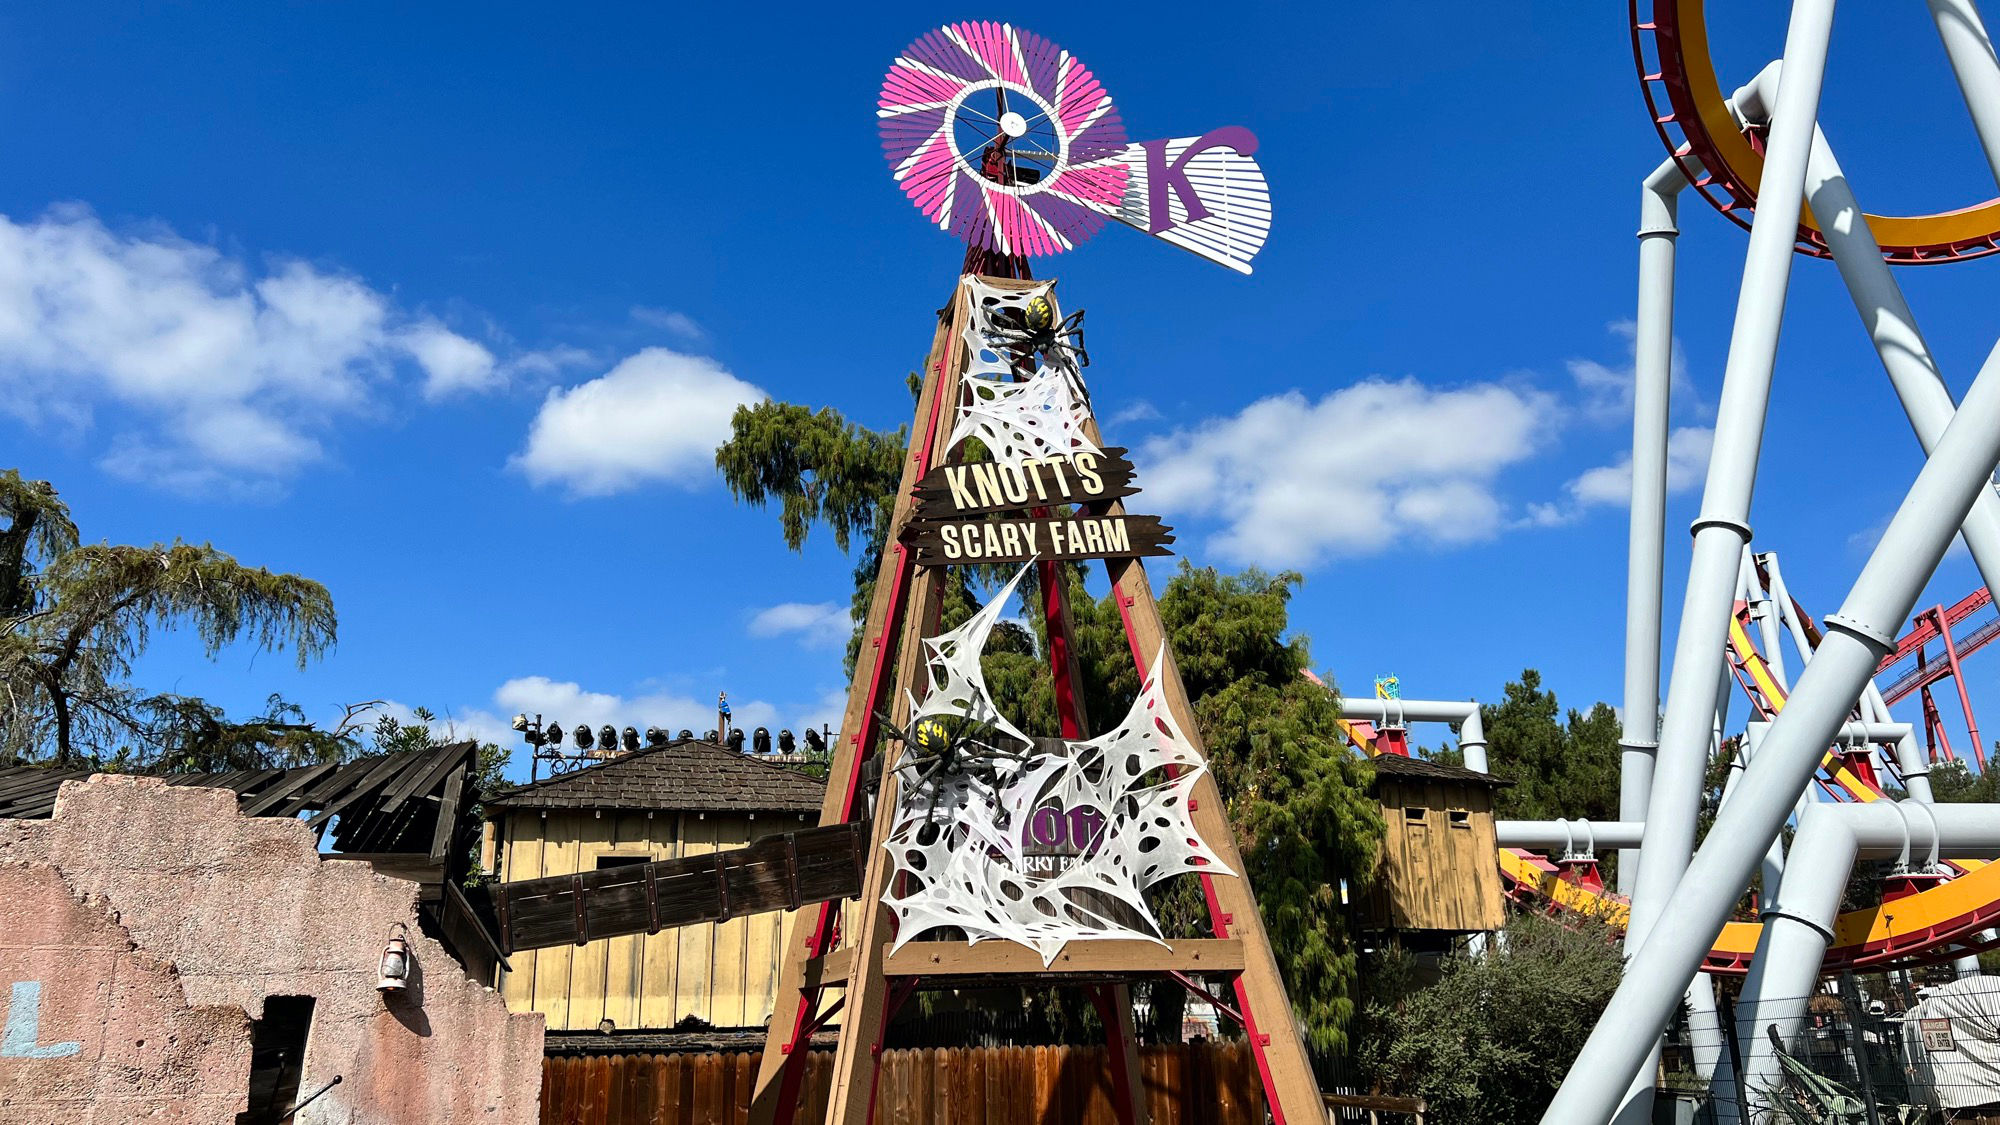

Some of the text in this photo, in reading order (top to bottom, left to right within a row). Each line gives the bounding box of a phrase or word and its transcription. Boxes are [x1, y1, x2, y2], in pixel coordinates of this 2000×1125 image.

[1139, 125, 1259, 235] K
[944, 453, 1104, 510] KNOTT'S
[940, 518, 1131, 559] SCARY FARM
[0, 980, 81, 1059] L
